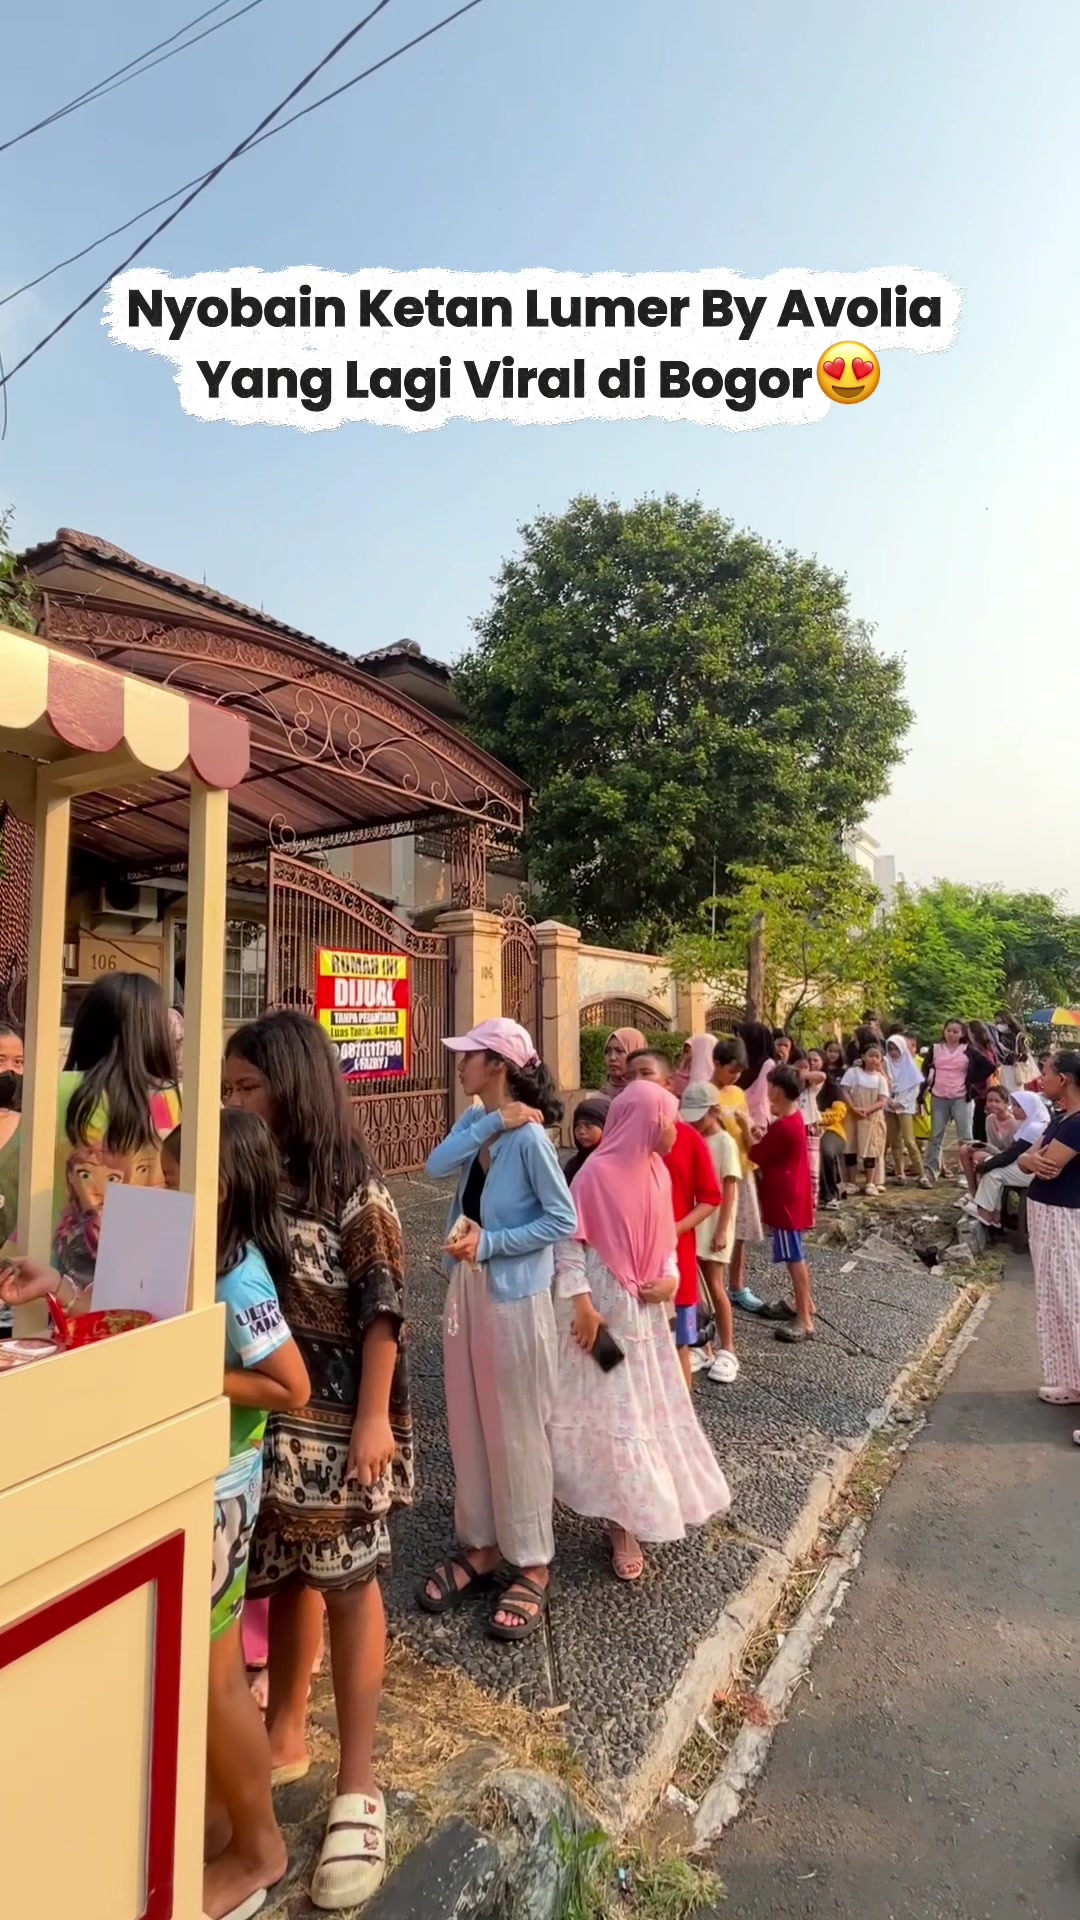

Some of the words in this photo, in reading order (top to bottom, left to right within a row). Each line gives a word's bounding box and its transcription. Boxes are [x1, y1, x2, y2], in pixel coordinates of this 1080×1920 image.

[92, 953, 117, 970] 106
[331, 953, 379, 975] RUMAH
[334, 977, 398, 1008] DIJUAL
[331, 1027, 349, 1038] Luas
